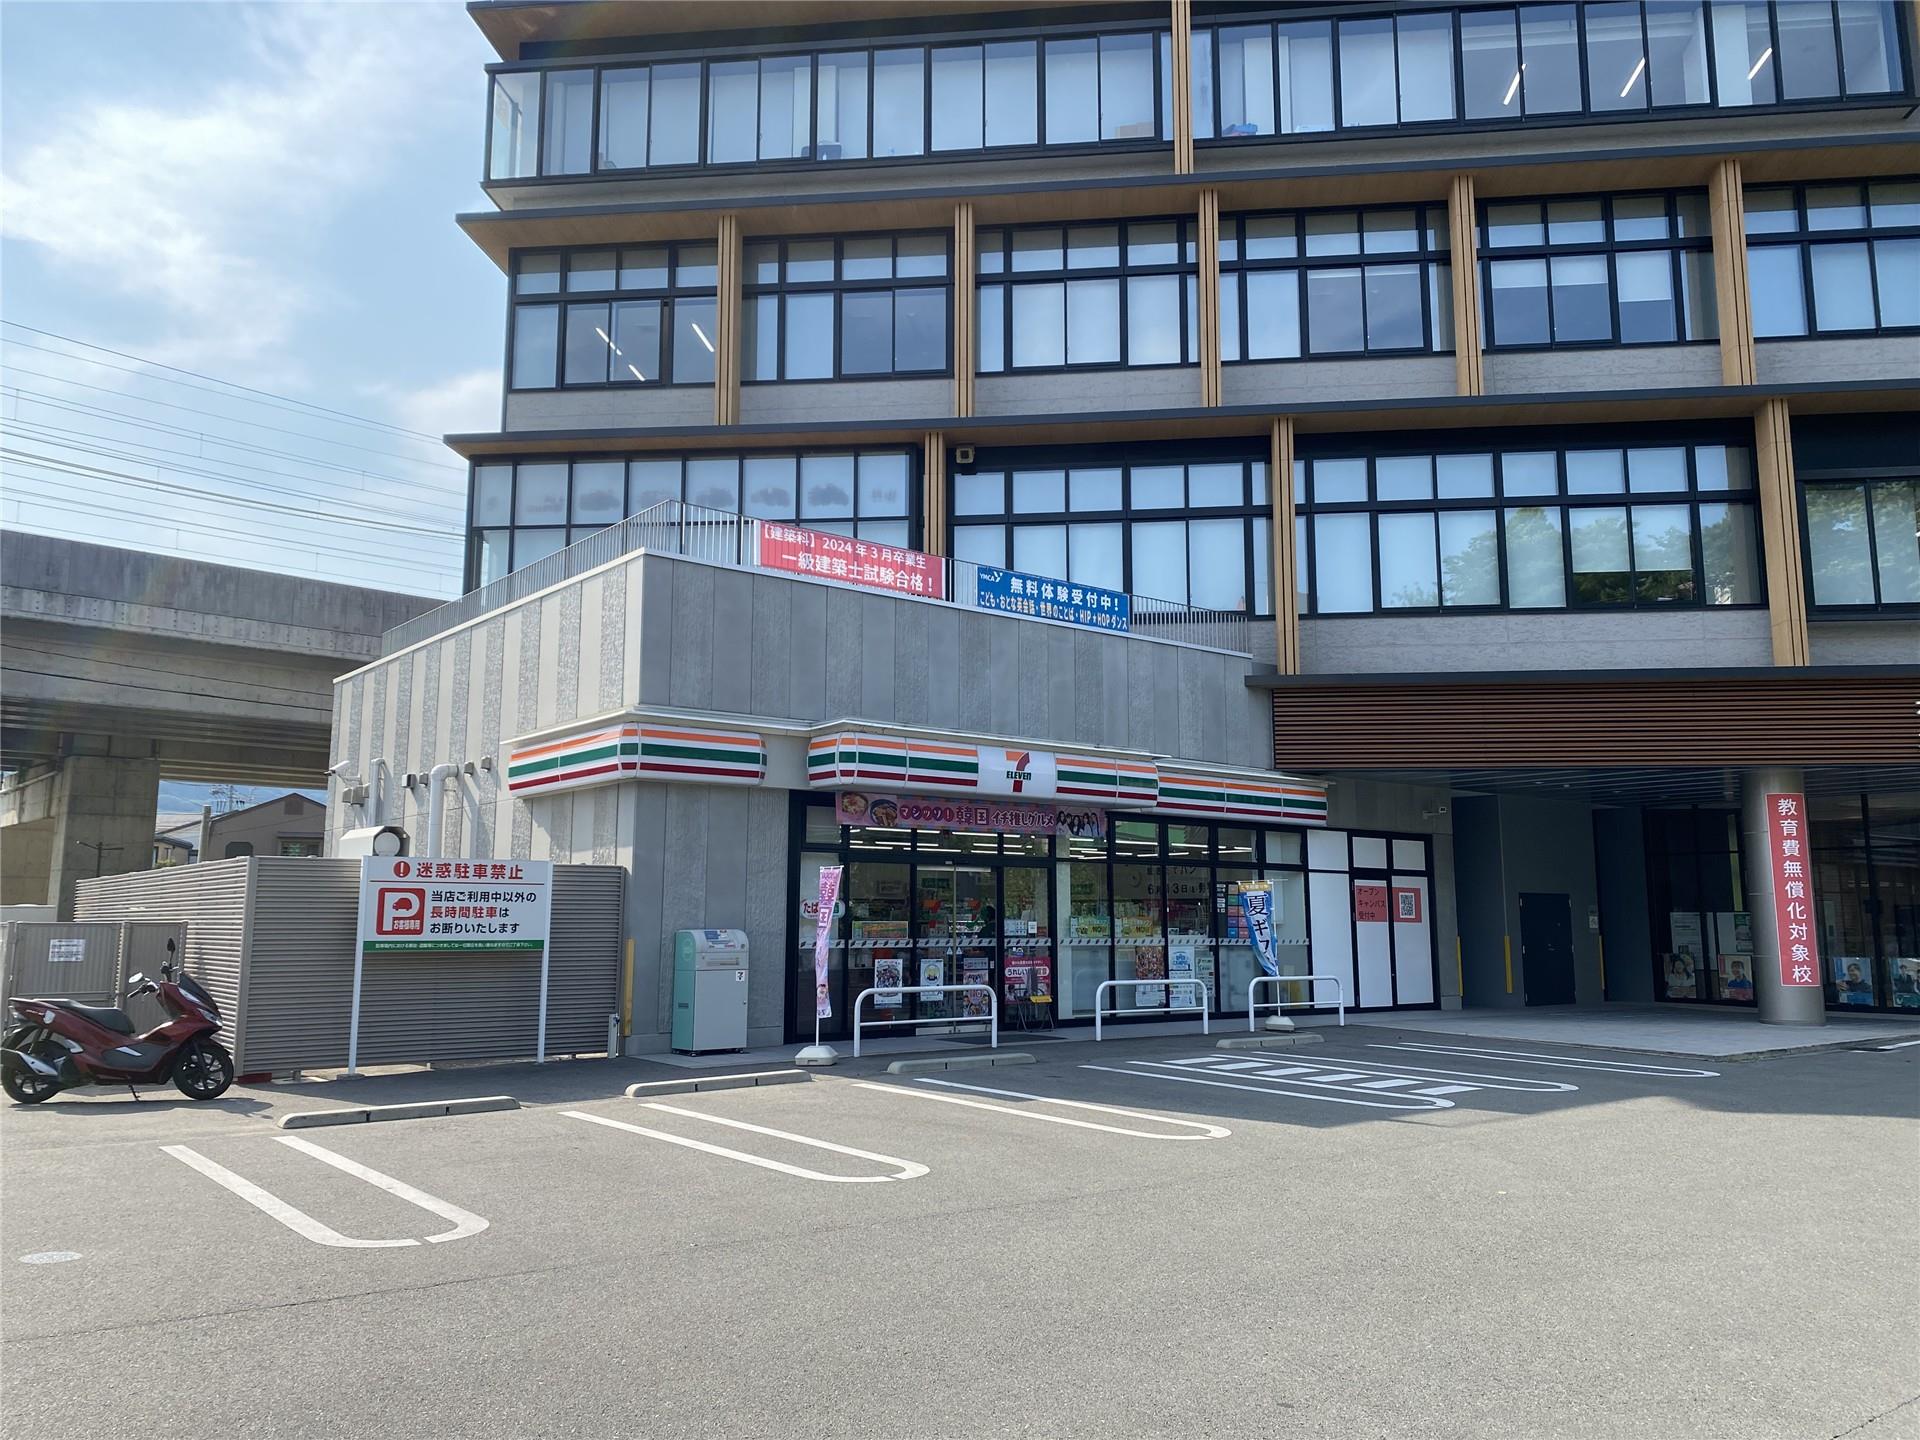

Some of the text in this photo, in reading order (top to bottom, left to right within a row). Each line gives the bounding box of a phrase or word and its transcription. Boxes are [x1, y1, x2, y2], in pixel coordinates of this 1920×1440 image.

[416, 862, 523, 880] 迷惑駐車禁止
[431, 890, 537, 903] 当店ご利用中以外の
[1357, 888, 1379, 896] オープン
[1778, 798, 1812, 983] 教育費無償化対象校
[1358, 900, 1386, 908] キャンパス
[430, 906, 509, 919] 長時間駐車は
[430, 922, 520, 934] お断りいたします
